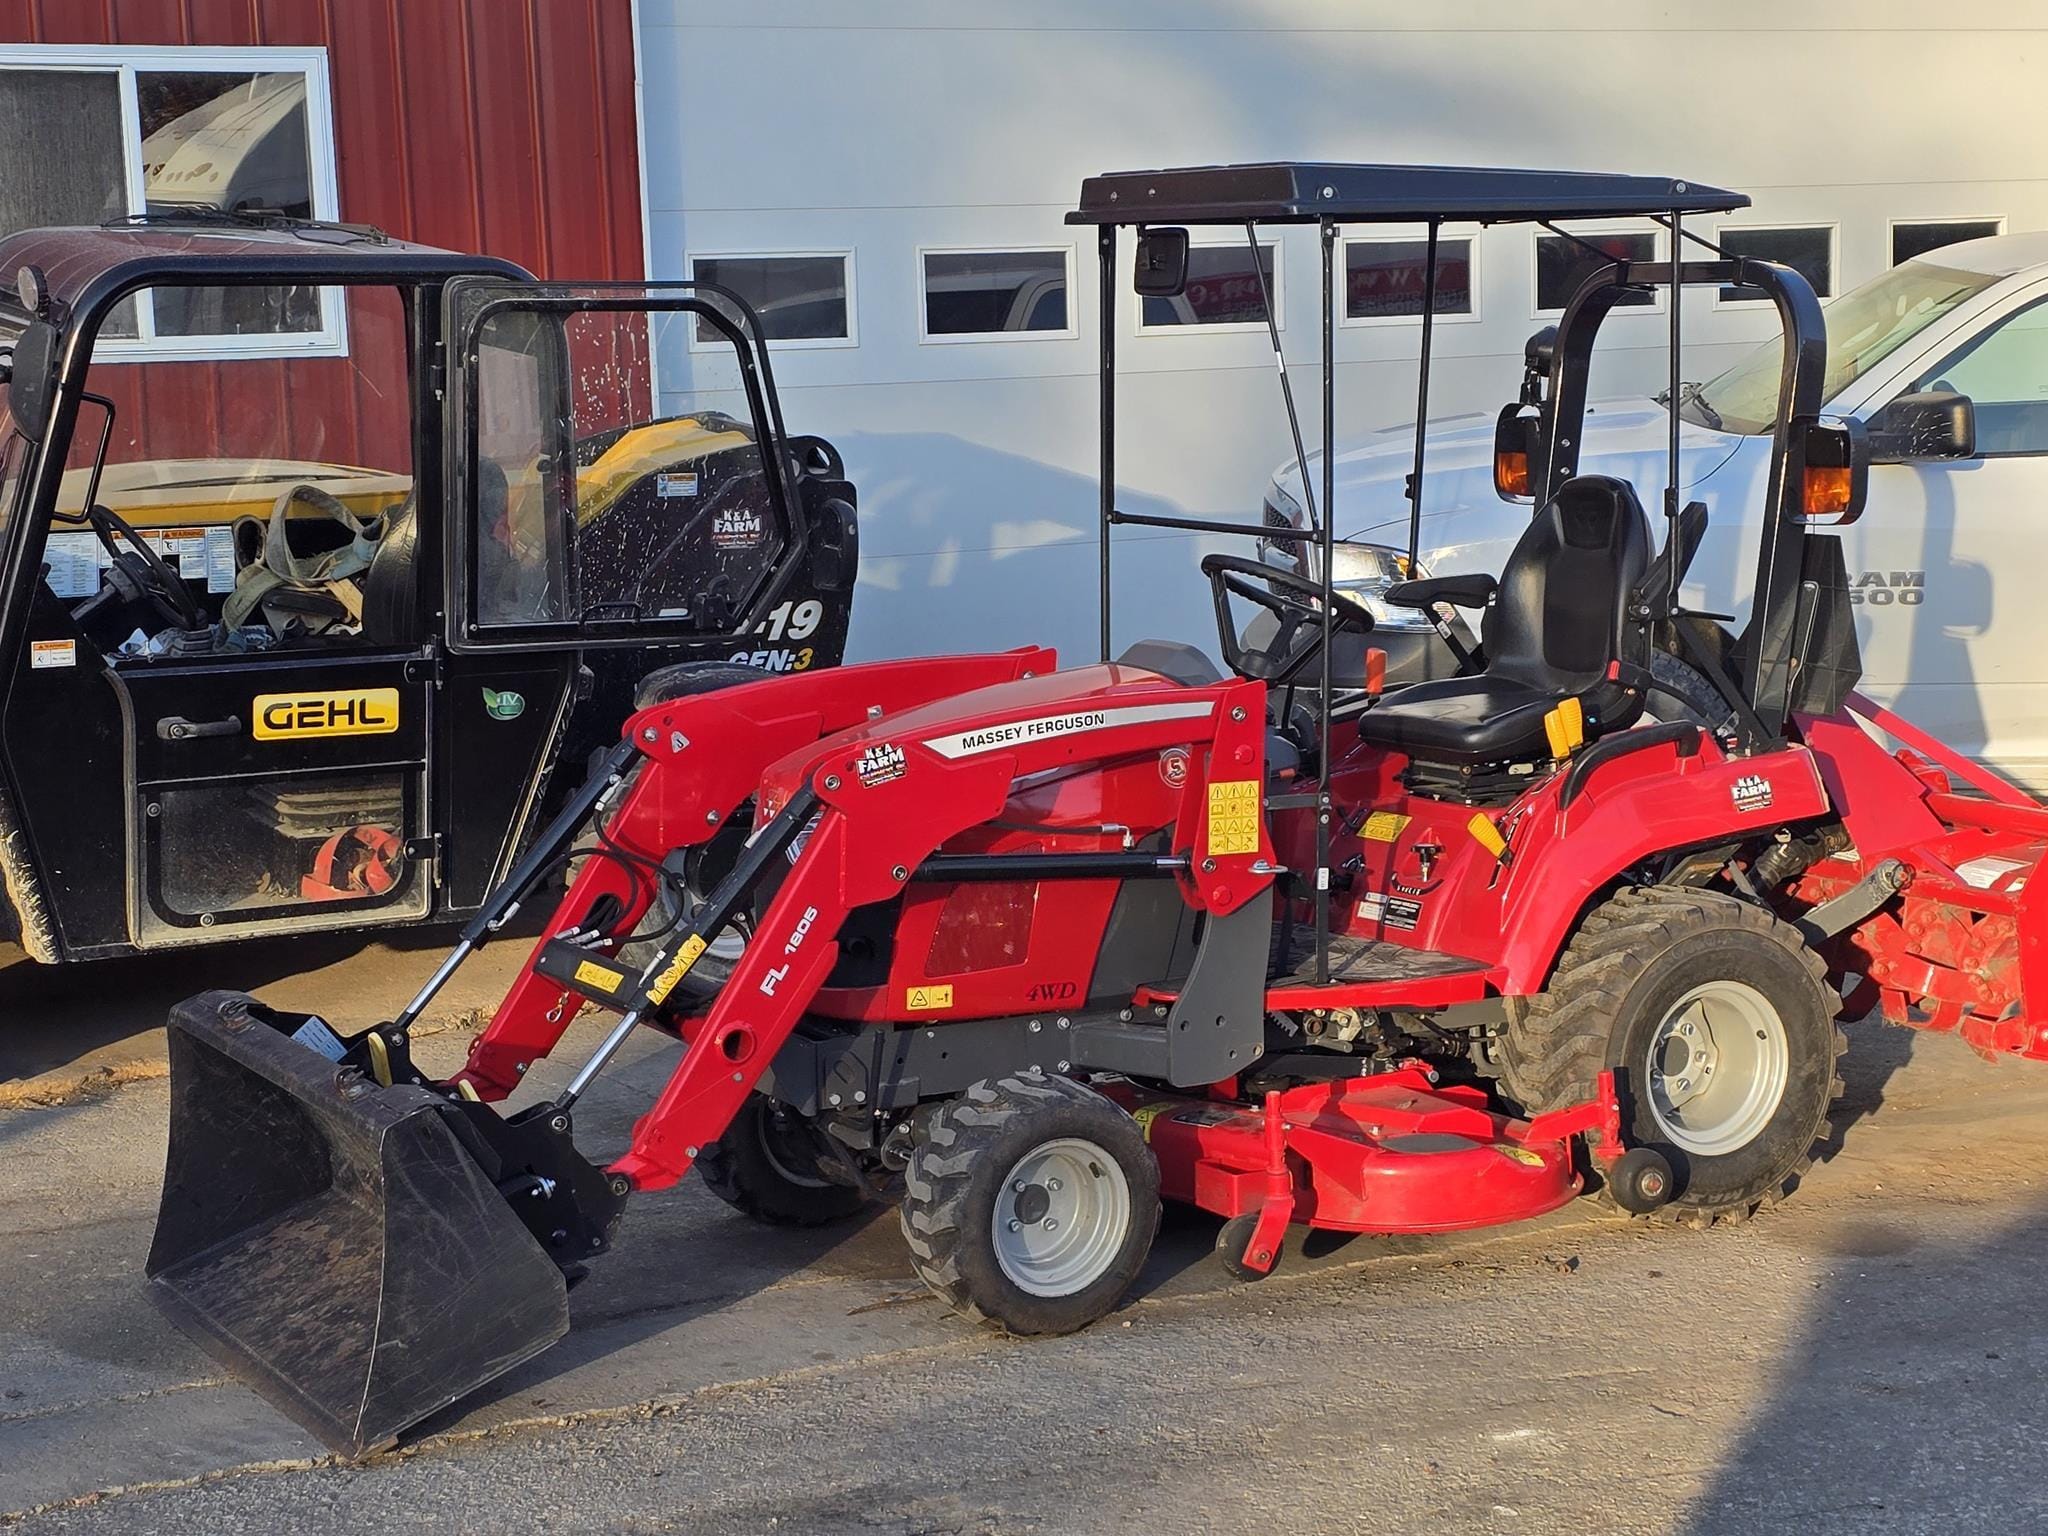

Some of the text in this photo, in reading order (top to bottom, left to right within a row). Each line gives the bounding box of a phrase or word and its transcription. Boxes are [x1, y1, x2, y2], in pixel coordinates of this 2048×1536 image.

[714, 518, 760, 533] FARM
[263, 698, 385, 730] GEHL
[962, 713, 1105, 749] MASSEY FERGUSON
[857, 747, 905, 774] FARM
[1731, 780, 1771, 799] FARM
[760, 905, 819, 997] FL 1805
[1025, 981, 1077, 1001] 4WD
